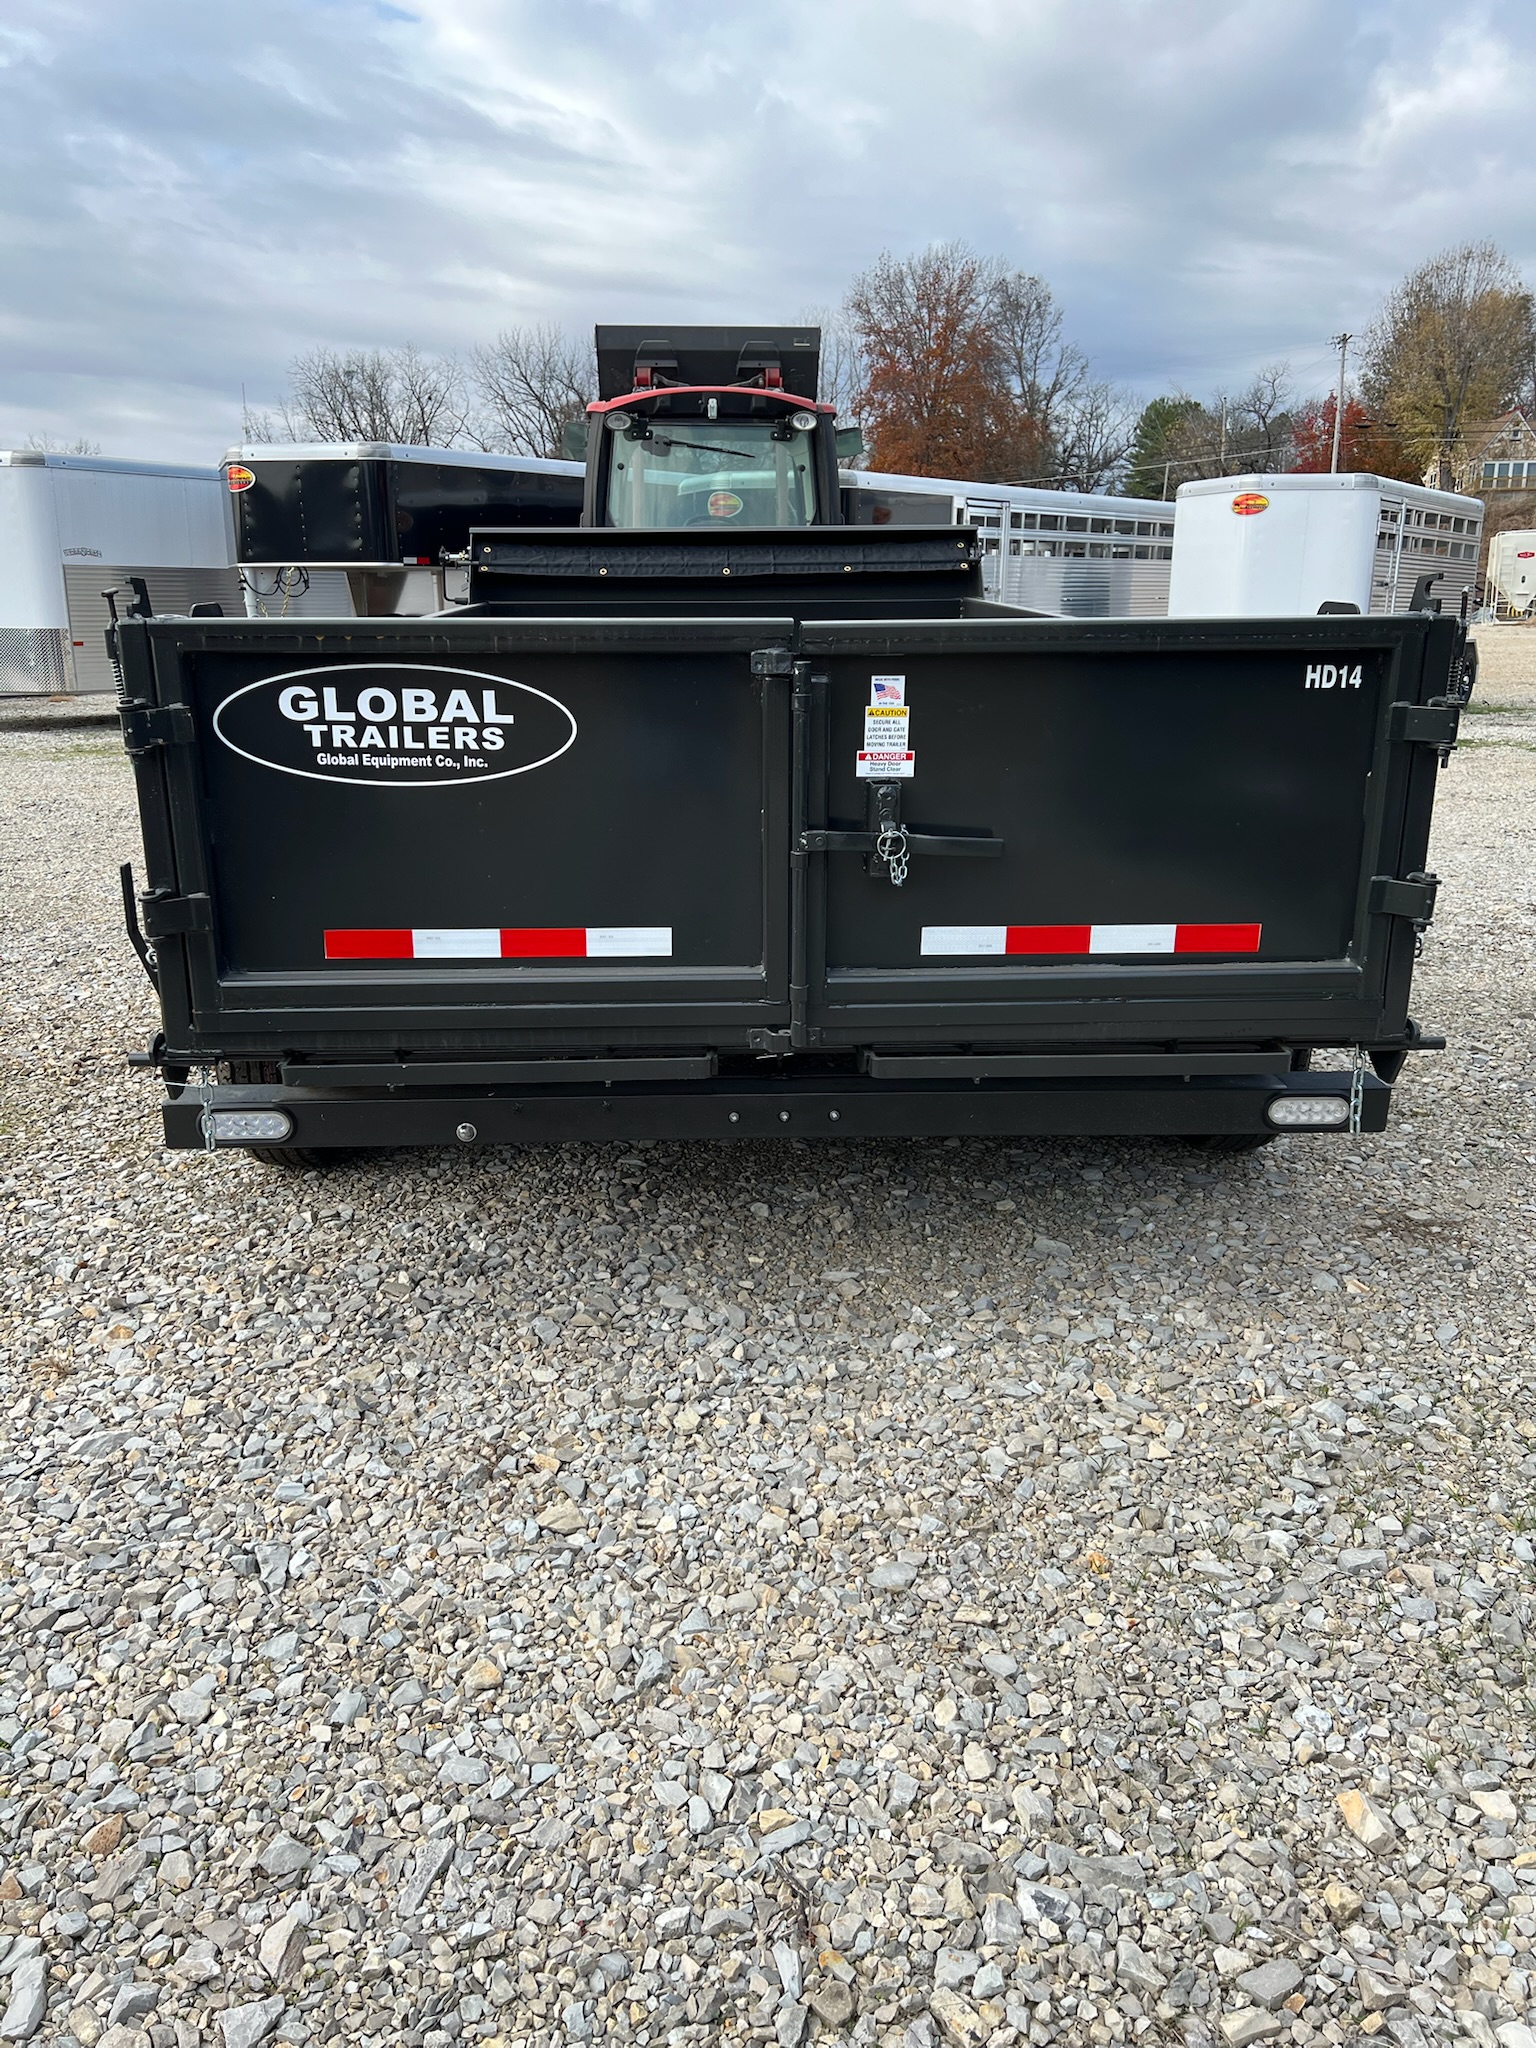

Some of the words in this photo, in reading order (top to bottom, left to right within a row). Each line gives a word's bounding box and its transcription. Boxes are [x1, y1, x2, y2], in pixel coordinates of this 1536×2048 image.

[1304, 664, 1363, 689] HD14
[278, 685, 515, 725] GLOBAL
[302, 724, 505, 751] TRAILERS
[316, 752, 359, 766] Global
[362, 753, 433, 769] Equipment
[434, 754, 461, 769] Co.,
[463, 755, 488, 768] Inc.
